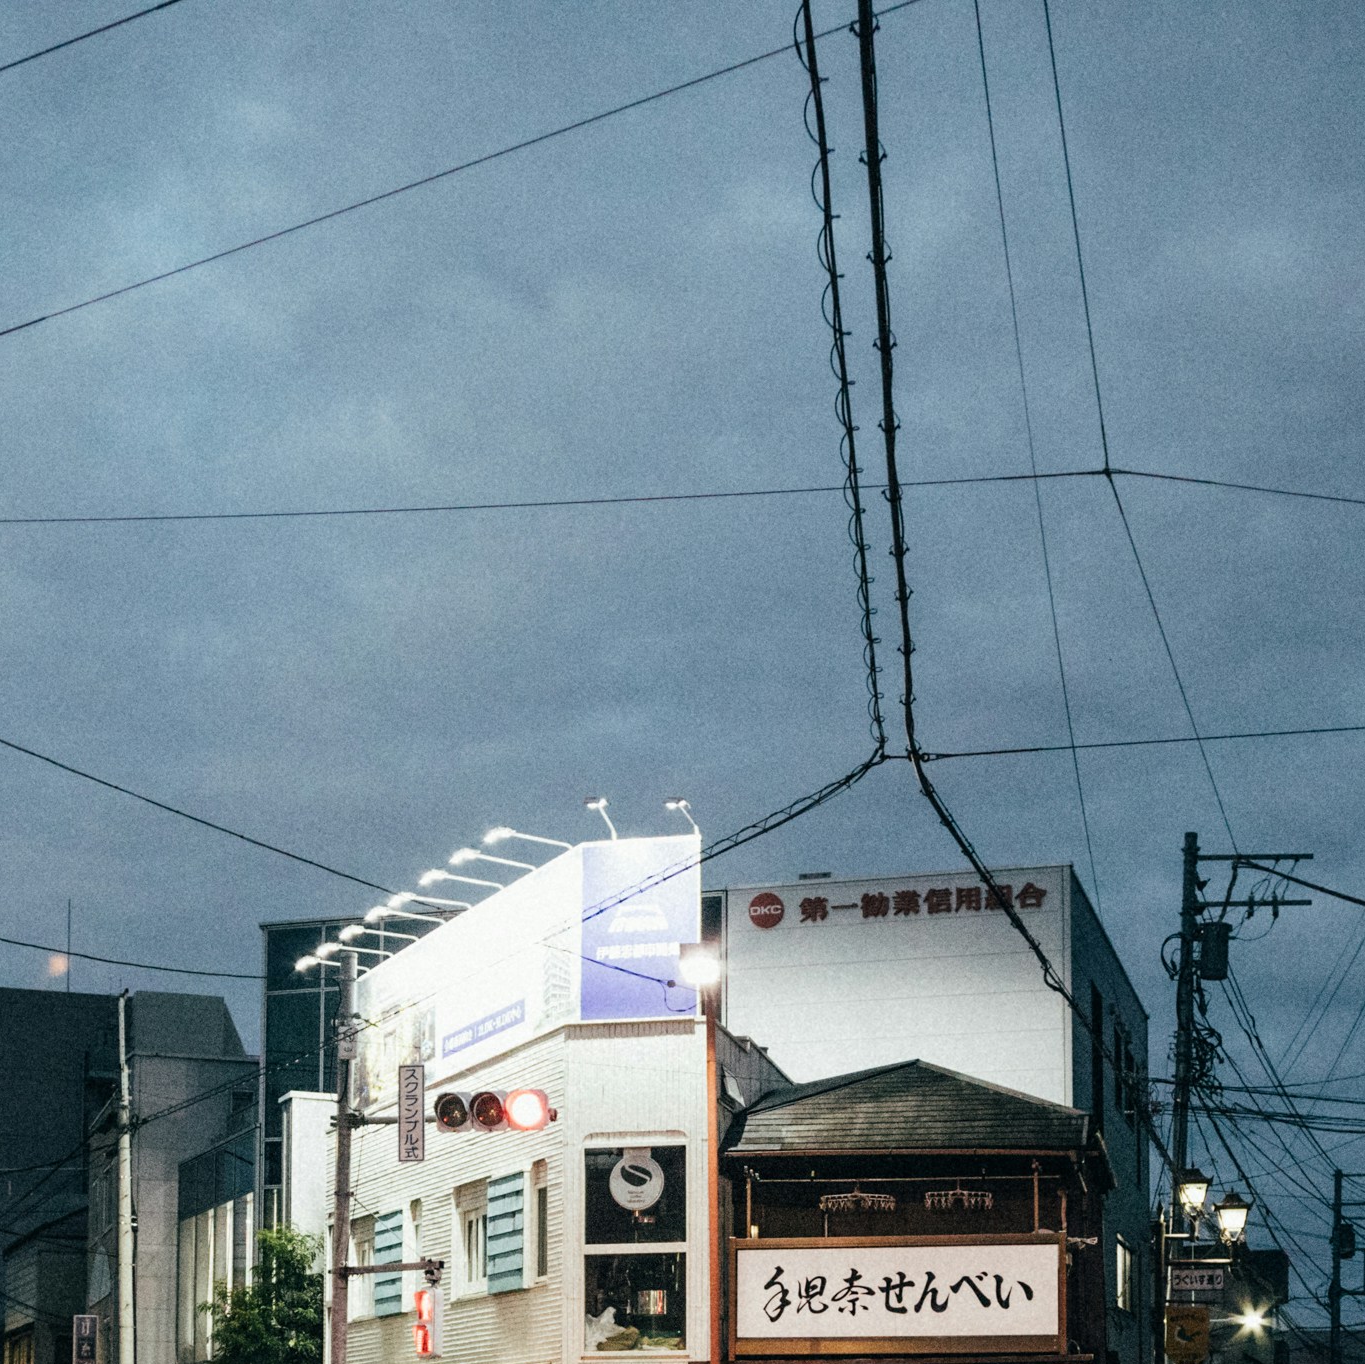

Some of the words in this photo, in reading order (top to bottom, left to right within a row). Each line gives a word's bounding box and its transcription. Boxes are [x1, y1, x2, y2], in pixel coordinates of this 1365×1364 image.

[749, 904, 783, 916] DKC
[798, 883, 1047, 922] 第一勧業信用組合
[404, 1068, 419, 1160] スクランブル式
[763, 1265, 1034, 1323] 手児奈せんべい
[1174, 1274, 1223, 1286] うぐいす通り
